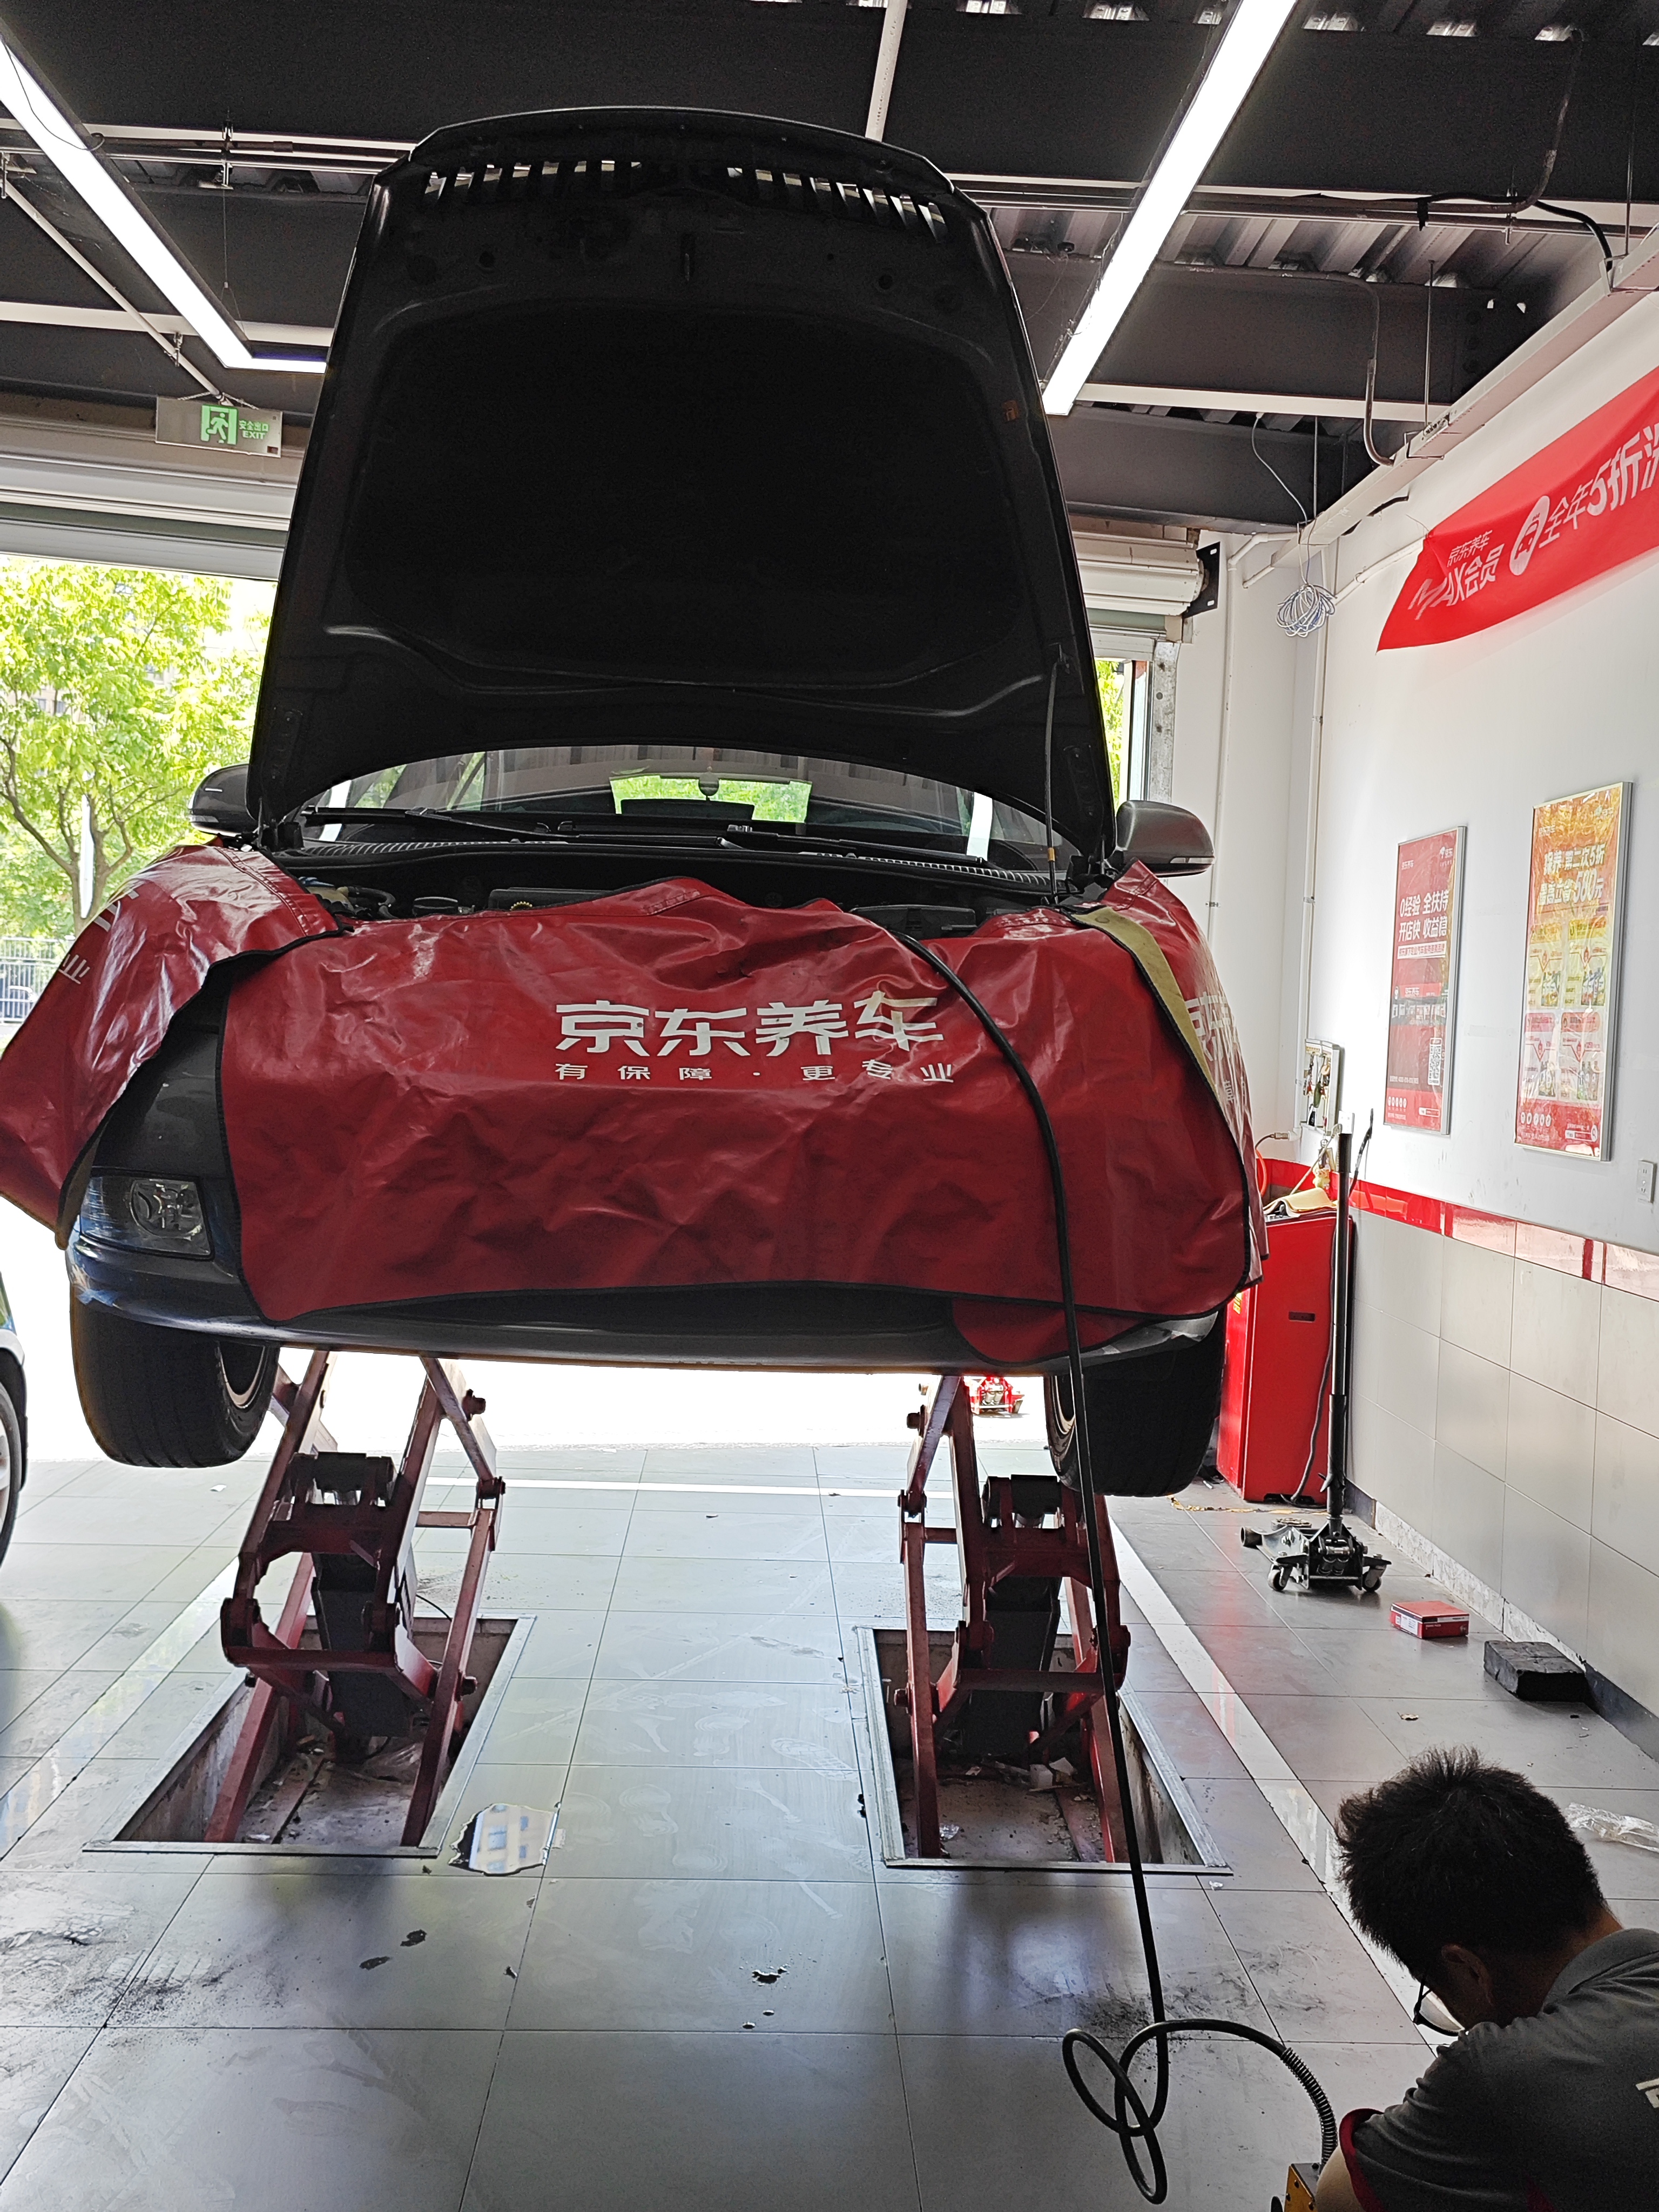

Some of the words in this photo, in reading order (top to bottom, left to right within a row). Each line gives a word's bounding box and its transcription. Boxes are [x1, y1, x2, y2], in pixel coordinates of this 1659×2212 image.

[239, 420, 269, 431] 安全出口
[242, 430, 266, 440] EXIT
[1447, 530, 1493, 567] 京东养车
[1407, 543, 1505, 621] MAX会员
[1564, 843, 1606, 871] 第二次5折
[1539, 868, 1604, 906] 最高立省580元
[1400, 894, 1421, 918] 0经验
[1422, 889, 1449, 914] 全扶持
[1398, 919, 1421, 942] 开店快
[1422, 915, 1448, 939] 收益稳
[555, 990, 944, 1057] 京东养车
